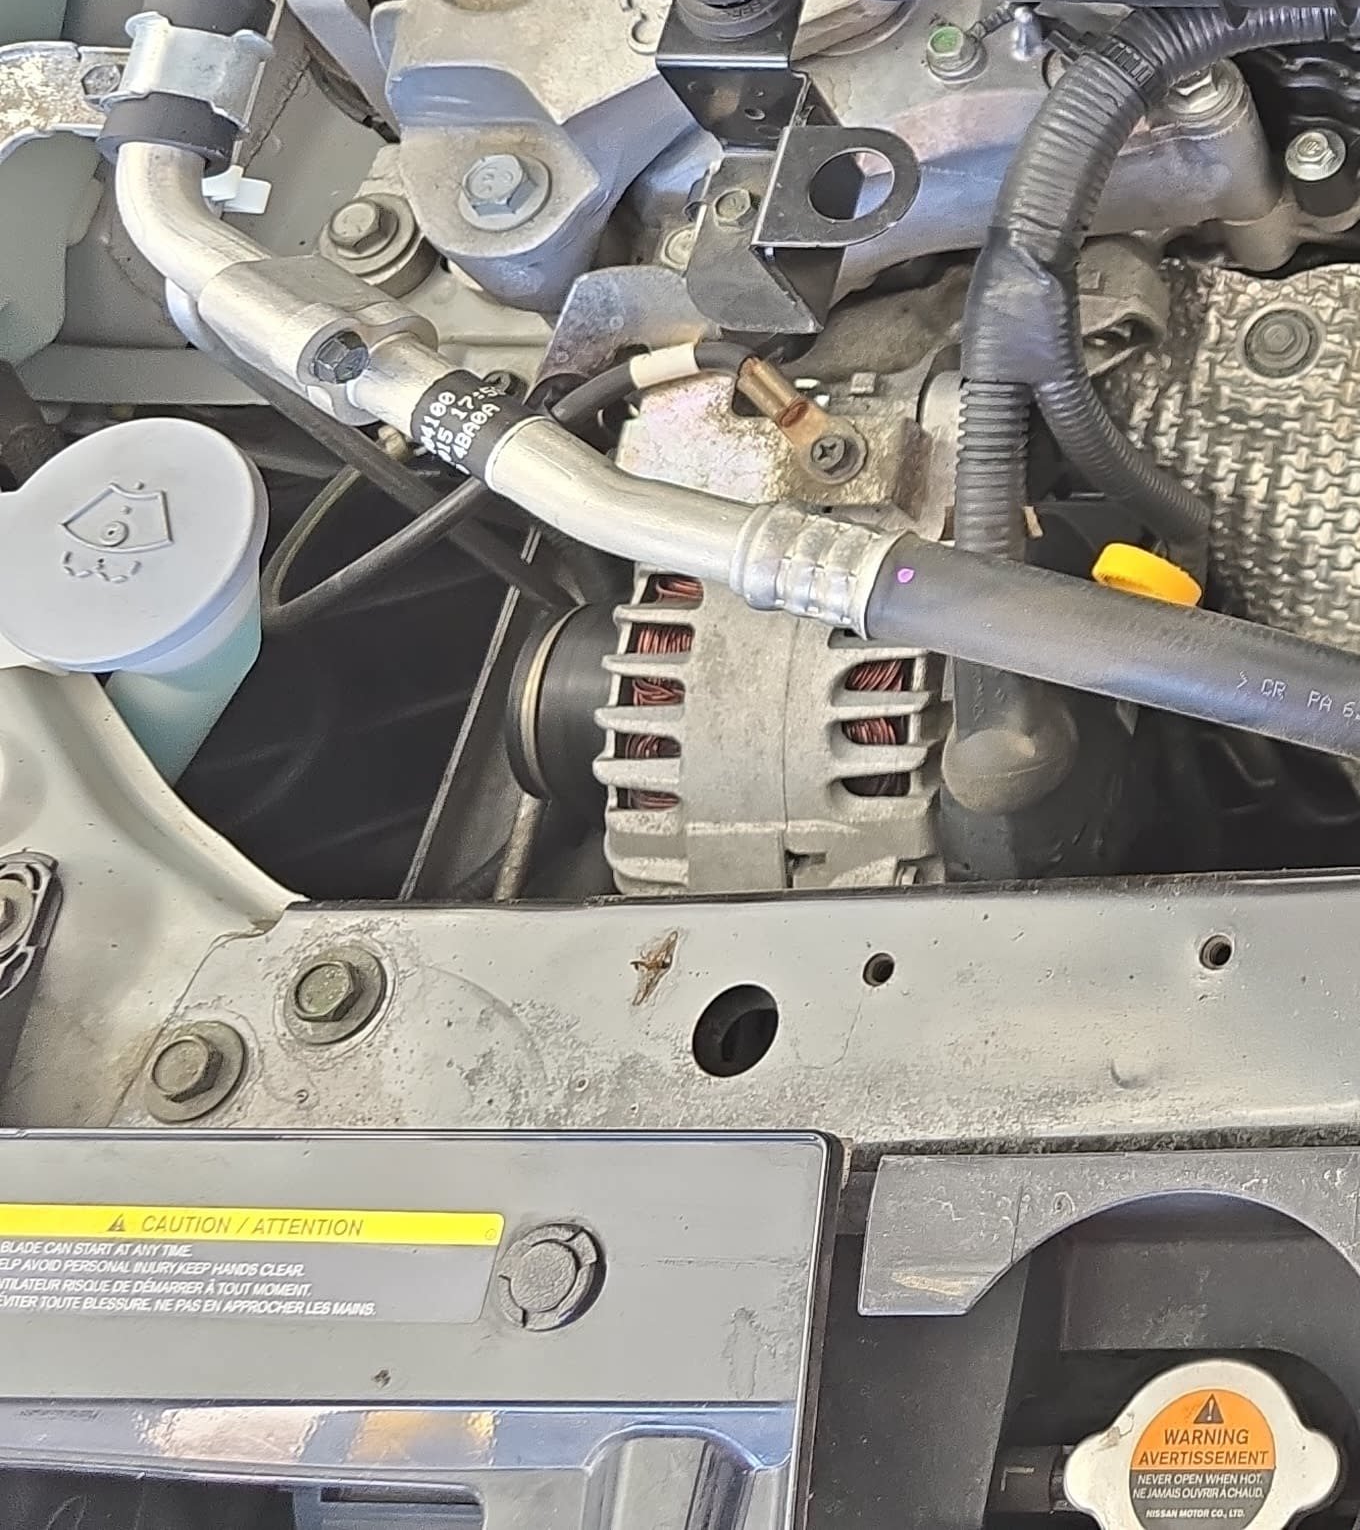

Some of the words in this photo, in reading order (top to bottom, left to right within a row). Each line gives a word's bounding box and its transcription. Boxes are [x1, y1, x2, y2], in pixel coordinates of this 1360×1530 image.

[1307, 689, 1333, 712] PA
[141, 1215, 231, 1234] CAUTION
[251, 1217, 365, 1237] ATTENTION
[1, 1242, 42, 1254] BLADE
[42, 1242, 76, 1256] CAN
[75, 1242, 114, 1256] START
[113, 1243, 133, 1256] AT
[134, 1243, 162, 1257] ANY
[162, 1244, 192, 1258] TIME.
[0, 1258, 22, 1270] ELP
[22, 1259, 64, 1271] AVOID
[63, 1259, 135, 1272] PERSONAL
[212, 1263, 259, 1277] HANDS
[259, 1263, 305, 1277] CLEAR.
[63, 1278, 112, 1293] RISQUE
[112, 1279, 132, 1293] DE
[133, 1277, 203, 1295] DÉMARRER
[217, 1282, 253, 1295] TOUT
[252, 1282, 312, 1297] MOMENT.
[38, 1295, 82, 1310] TOUTE
[82, 1296, 152, 1312] BLESSURE,
[155, 1299, 175, 1312] NE
[176, 1299, 202, 1312] PAS
[202, 1300, 222, 1313] EN
[222, 1300, 306, 1315] APPROCHER
[306, 1301, 332, 1314] LES
[331, 1302, 377, 1316] MAINS.
[1163, 1428, 1250, 1446] WARNING
[1138, 1451, 1270, 1465] AVERTISSEMENT
[1138, 1474, 1172, 1484] NEVER
[1173, 1474, 1202, 1484] OPEN
[1205, 1474, 1238, 1484] WHEN
[1240, 1474, 1263, 1484] HOT.
[1133, 1489, 1147, 1498] NE
[1147, 1488, 1182, 1499] JAMAIS
[1182, 1488, 1219, 1498] OUVRIR
[1219, 1485, 1228, 1498] À
[1228, 1488, 1264, 1498] CHAUD.
[1146, 1509, 1178, 1518] NISSAN
[1178, 1509, 1209, 1518] MOTOR
[1211, 1509, 1227, 1518] CO.,
[1229, 1509, 1245, 1518] LTD.
